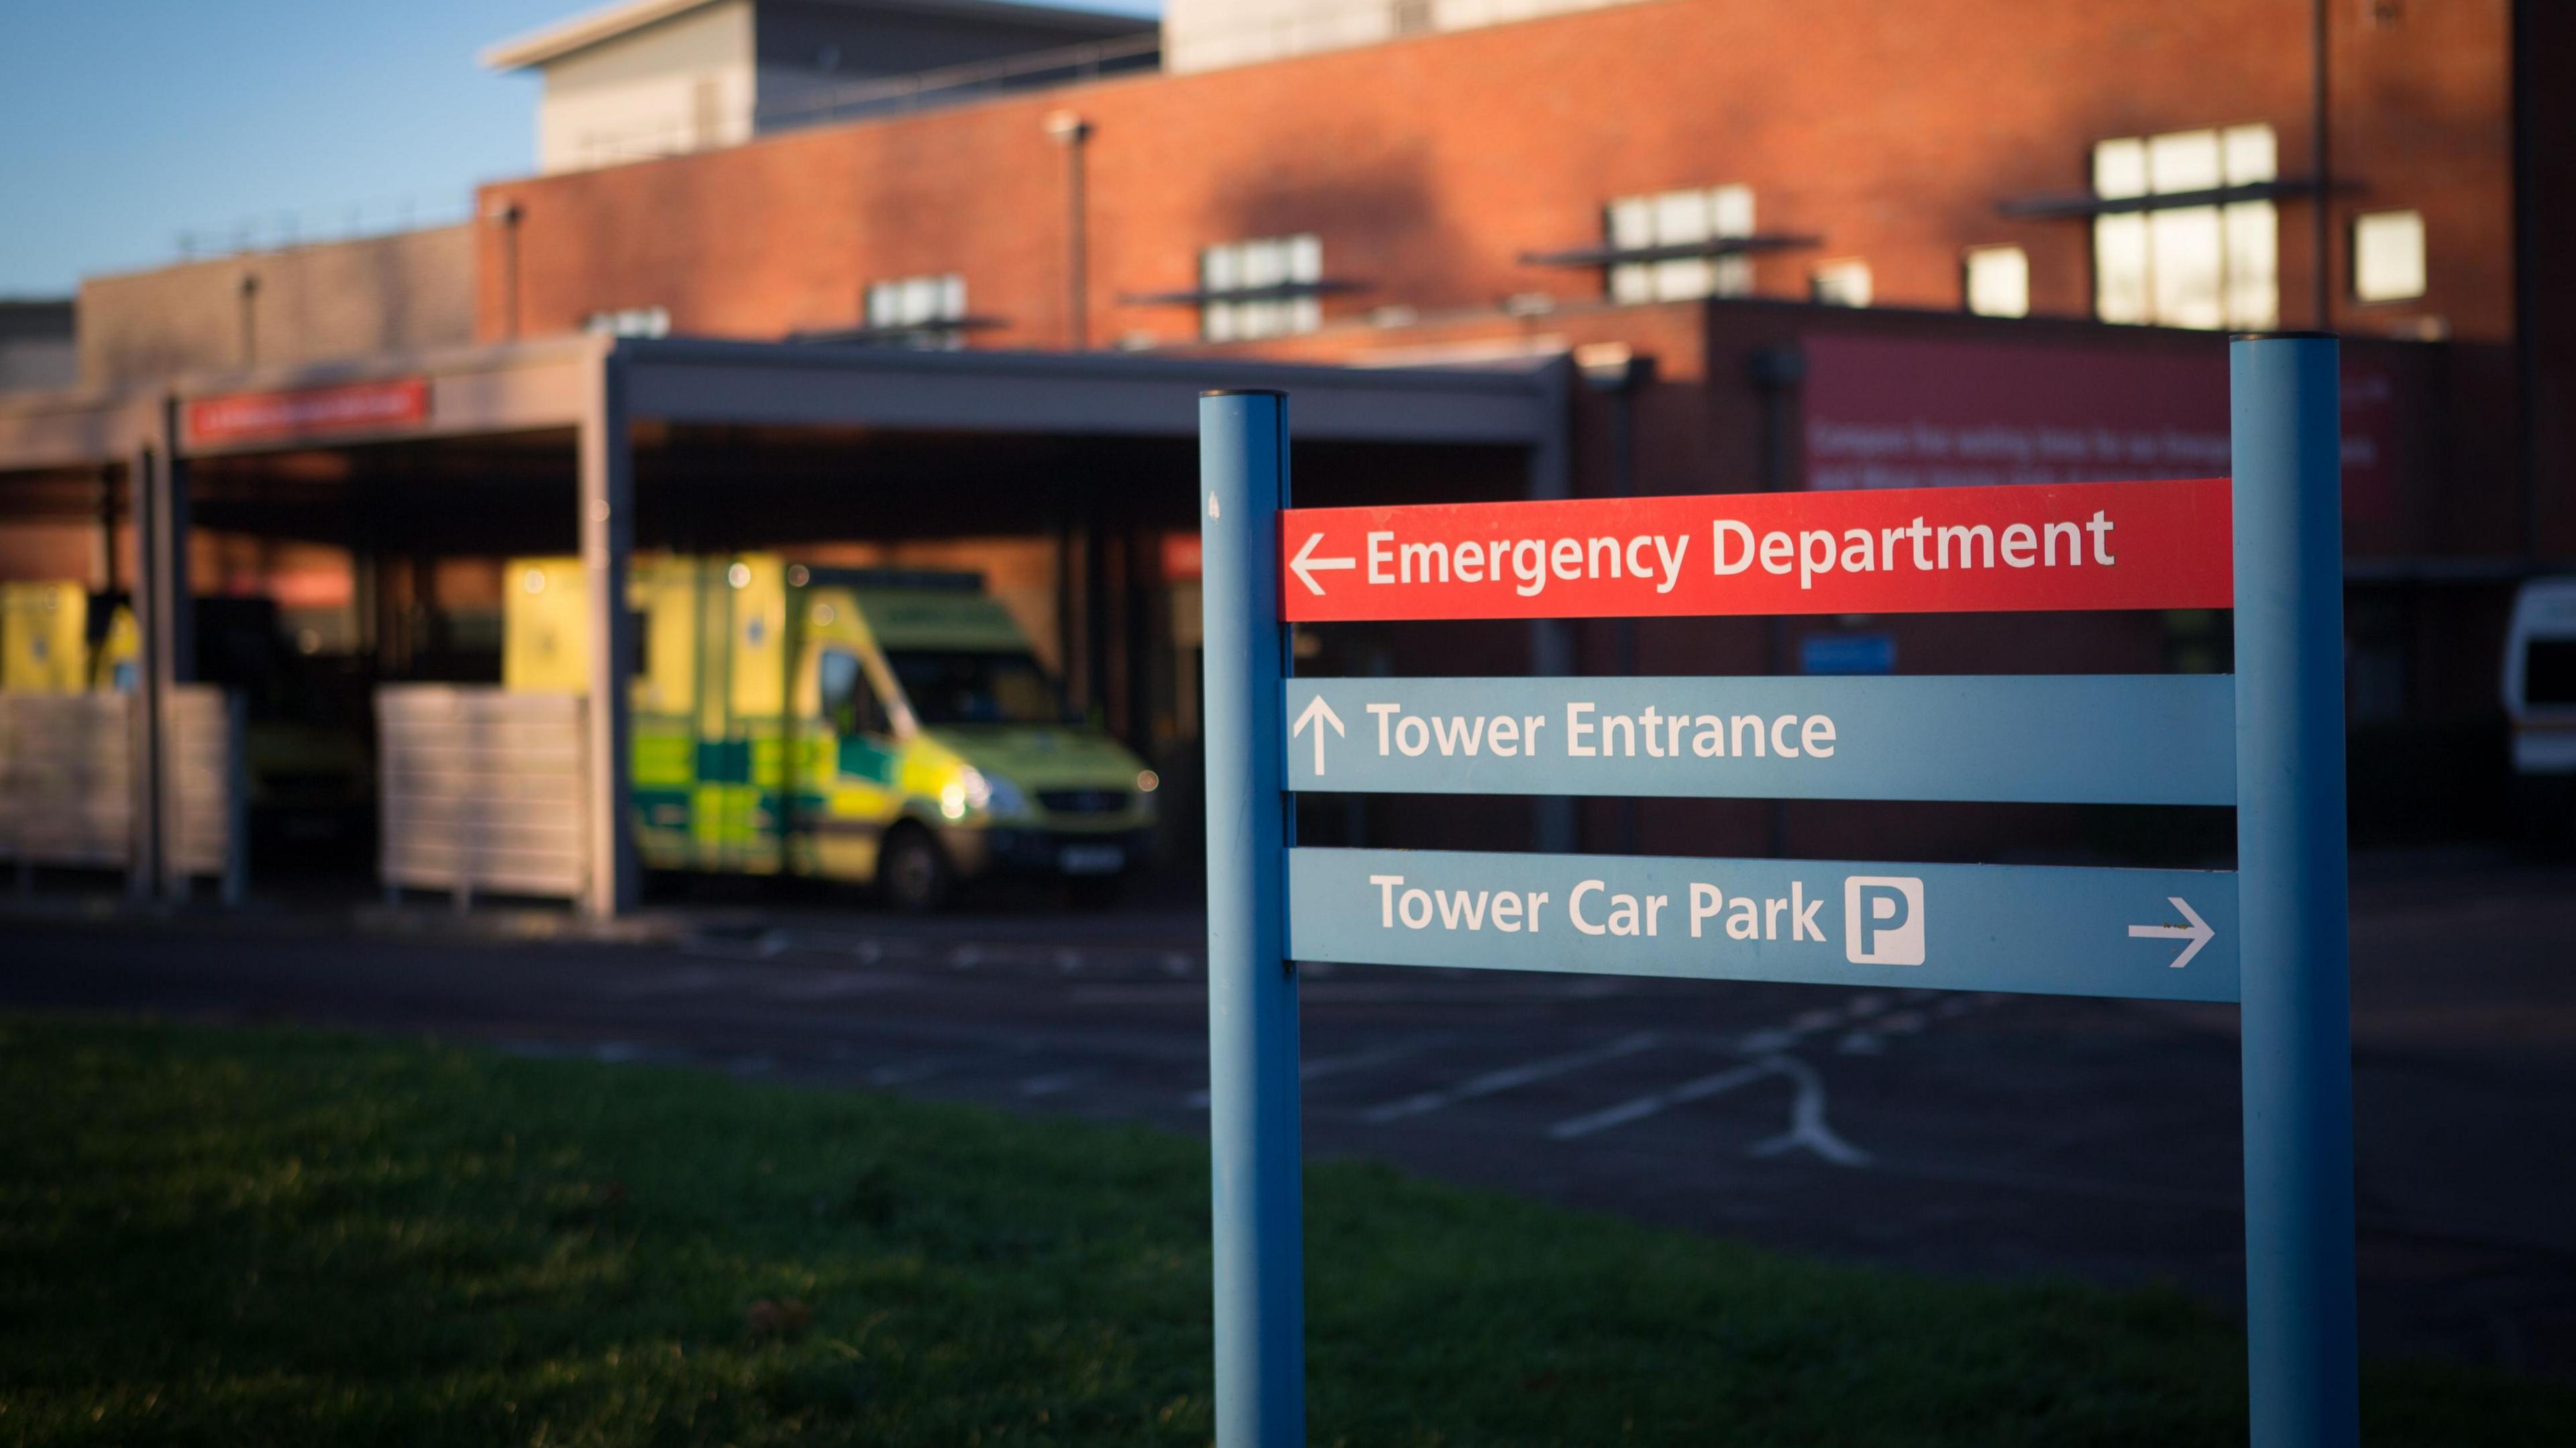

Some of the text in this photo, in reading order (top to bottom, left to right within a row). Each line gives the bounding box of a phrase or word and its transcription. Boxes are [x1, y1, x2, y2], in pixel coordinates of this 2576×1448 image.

[1368, 511, 2114, 596] Emergency Department
[1366, 702, 1836, 757] Tower Entrance
[1369, 875, 1548, 932] Tower
[1569, 880, 1668, 936] Car
[1690, 881, 1827, 942] Park
